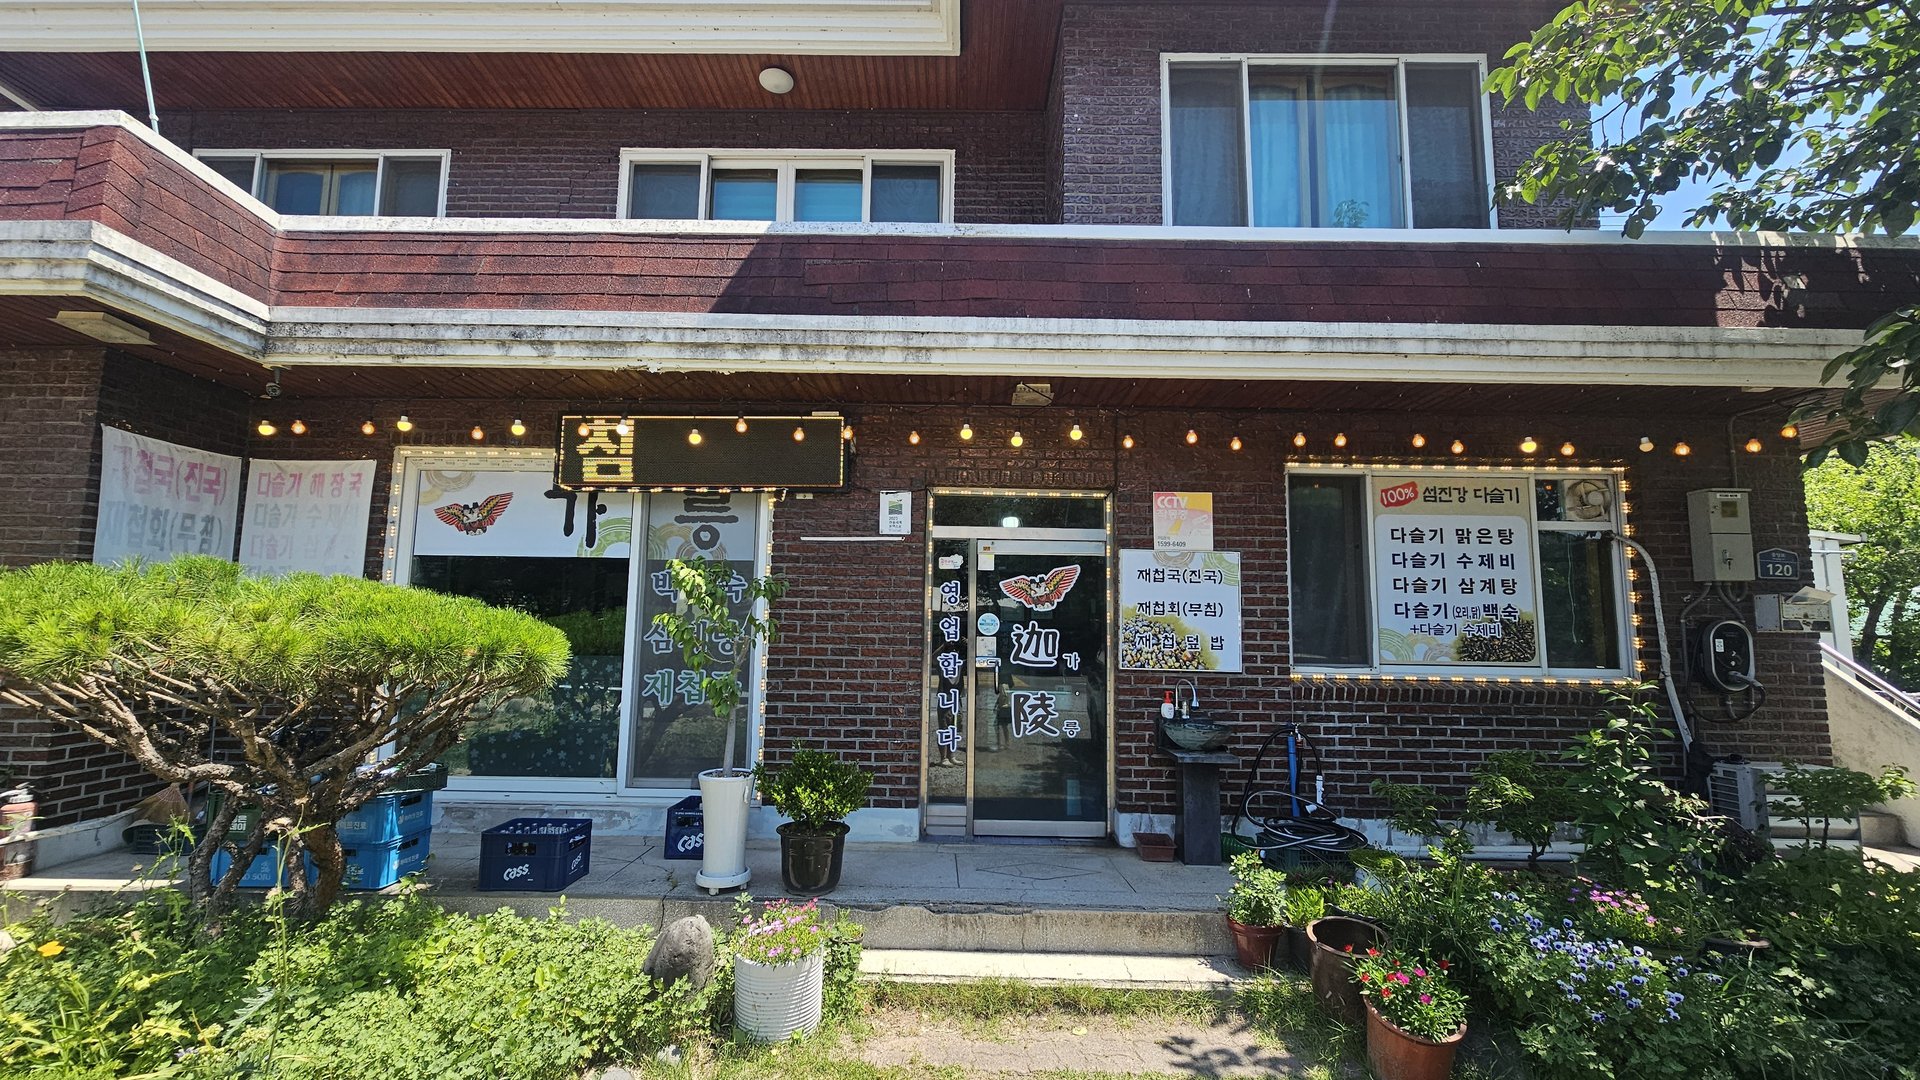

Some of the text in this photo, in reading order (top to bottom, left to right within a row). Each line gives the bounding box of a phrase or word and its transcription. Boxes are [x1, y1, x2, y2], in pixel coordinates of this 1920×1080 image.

[257, 472, 303, 498] 다슬기
[1157, 496, 1188, 508] CCTV
[1381, 486, 1520, 506] 100% 섬진강 다슬기
[253, 502, 298, 528] 다슬기
[1390, 527, 1514, 545] 다슬기 맑은탕
[1392, 552, 1516, 570] 다슬기 수제비
[1767, 563, 1792, 577] 120
[1137, 568, 1224, 586] 재첩국(진국)
[1393, 577, 1517, 595] 다슬기 삼계탕
[1137, 600, 1224, 618] 재첩회(무침)
[1394, 602, 1449, 620] 다슬기
[1410, 622, 1502, 638] +다슬기 수제비
[937, 581, 962, 752] 영업합니다
[1062, 652, 1081, 671] 가
